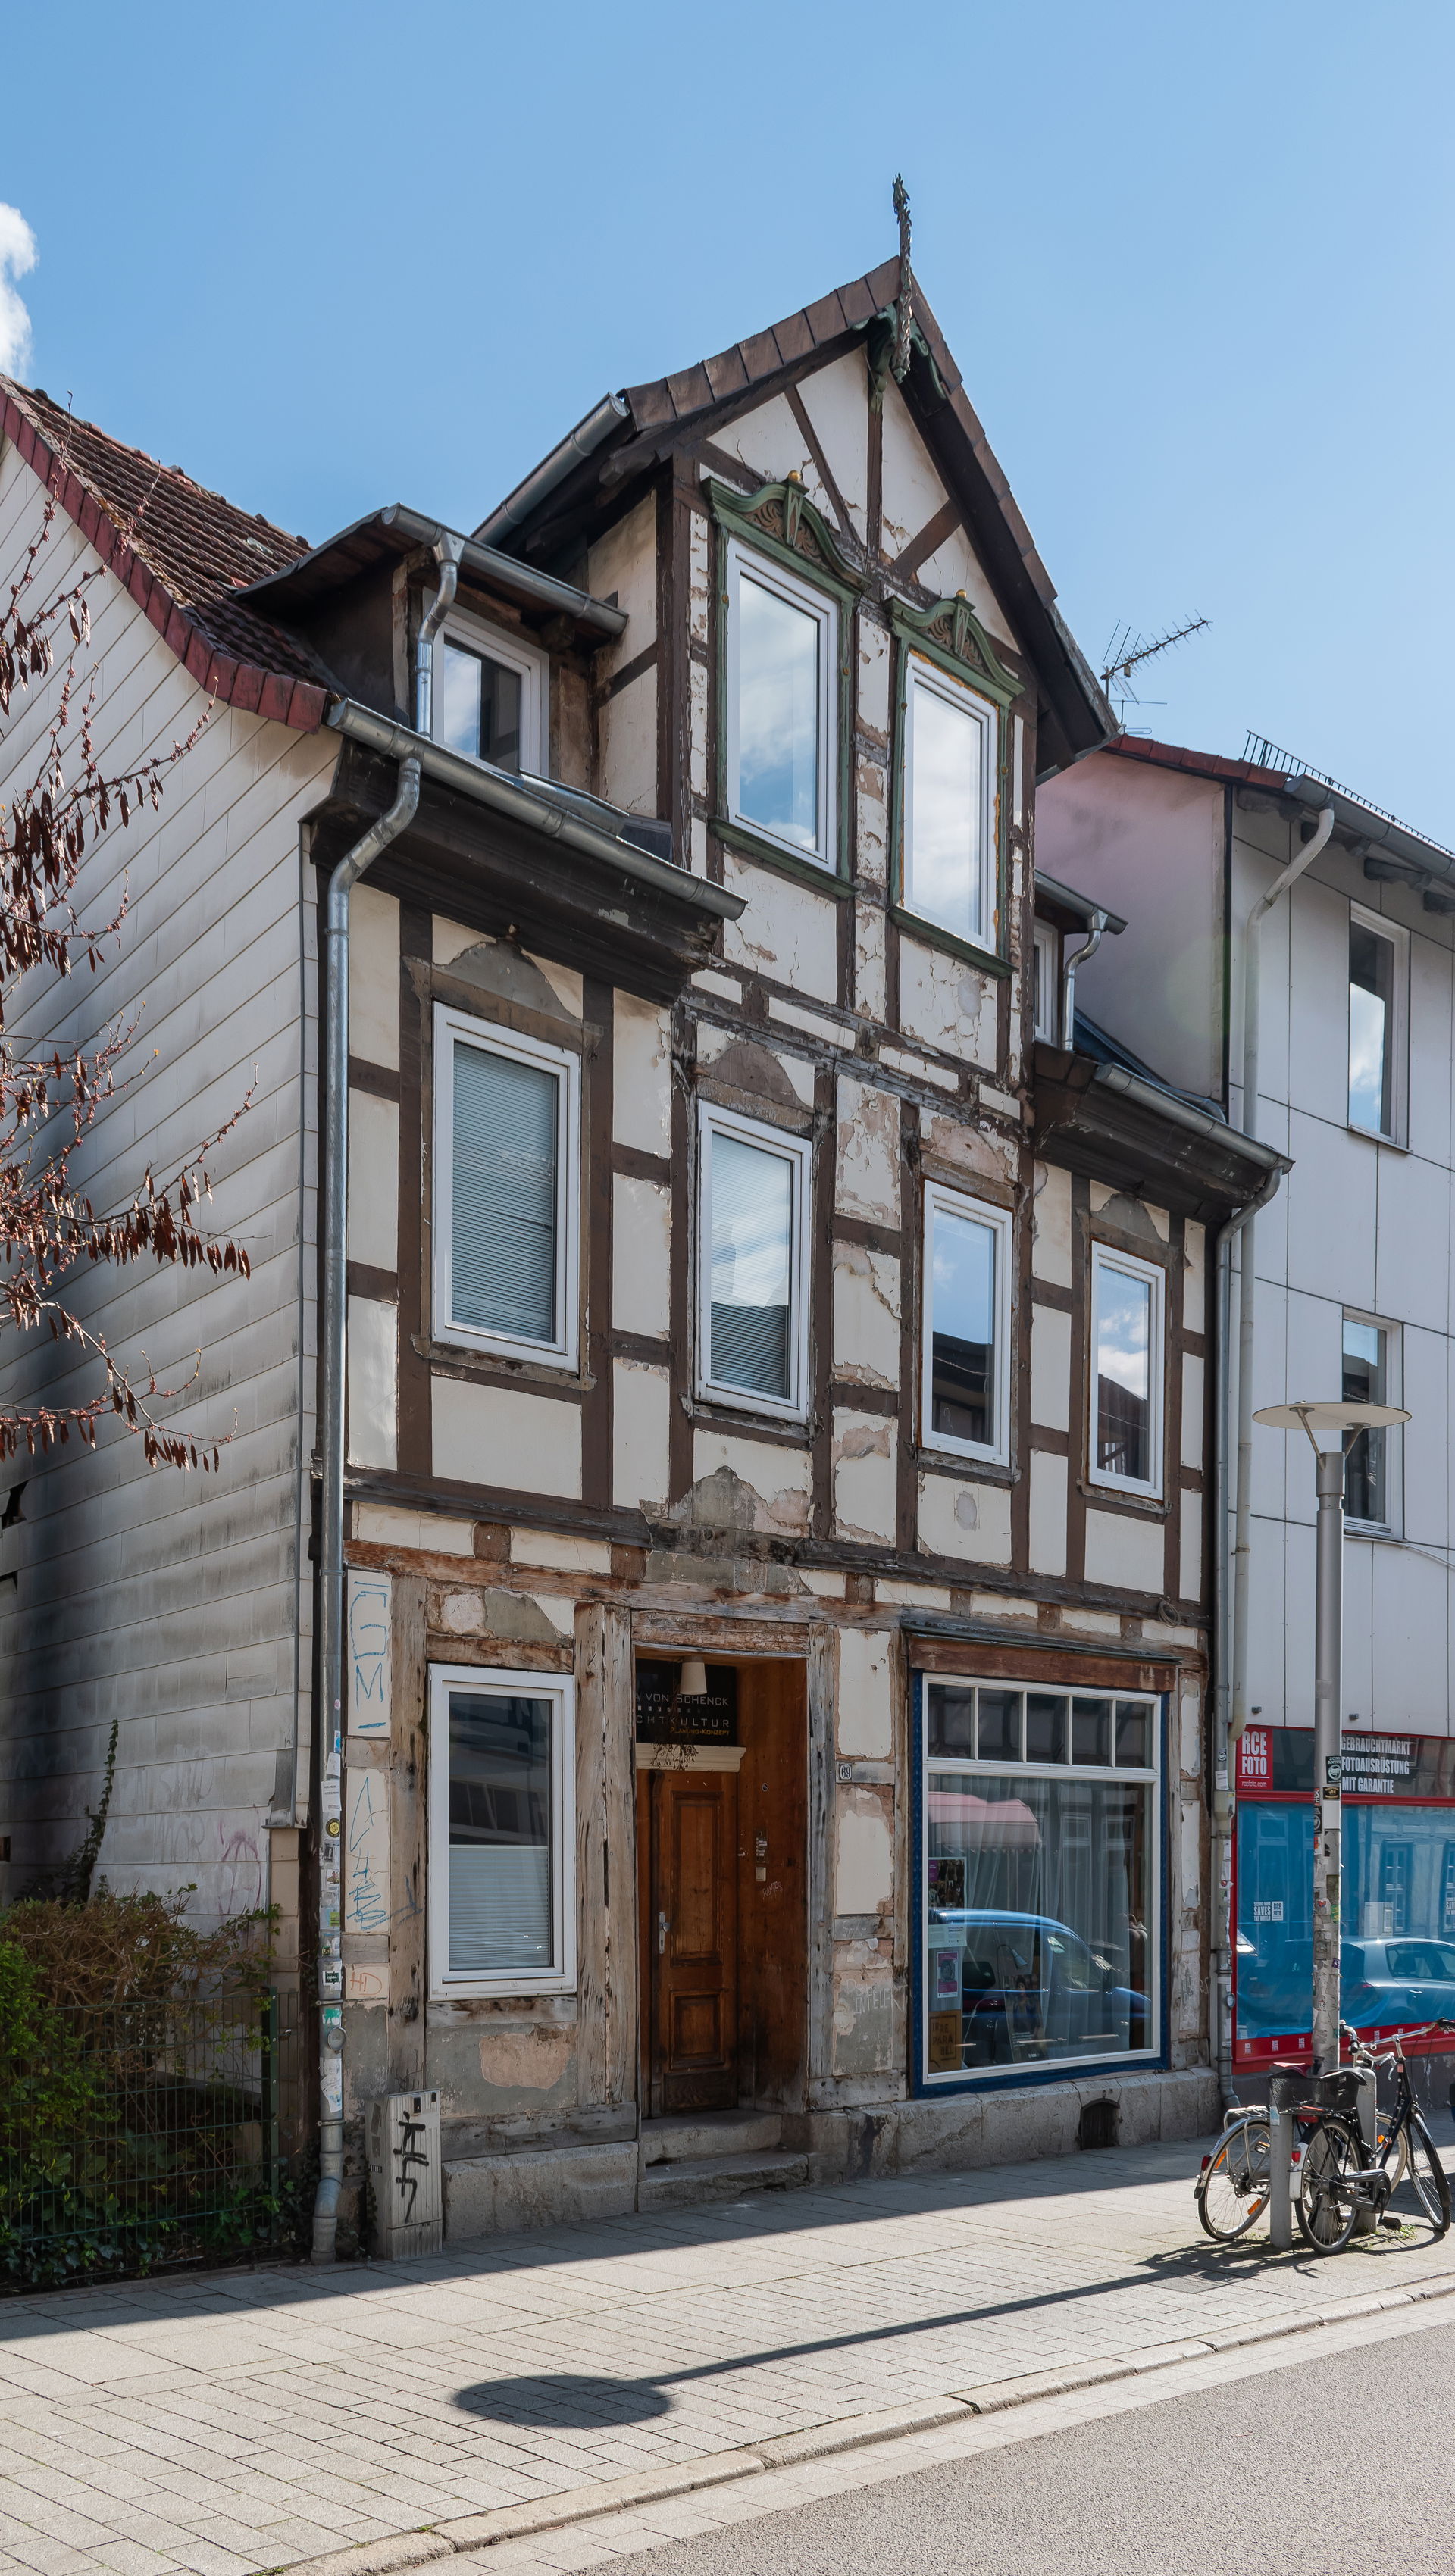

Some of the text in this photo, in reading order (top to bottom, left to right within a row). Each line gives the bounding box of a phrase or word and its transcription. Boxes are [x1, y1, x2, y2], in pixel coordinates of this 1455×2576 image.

[646, 1694, 669, 1703] VON
[677, 1694, 729, 1706] SCHENCK
[1242, 1731, 1267, 1755] RCE
[1341, 1737, 1410, 1755] GEBRAUCHTMARKT
[841, 1765, 850, 1779] 69
[1242, 1756, 1267, 1775] FOTO
[1341, 1756, 1410, 1774] FOTOAUSRÜSTUNG
[1342, 1777, 1394, 1793] MIT GARANTIE
[1254, 1905, 1271, 1916] SAVES
